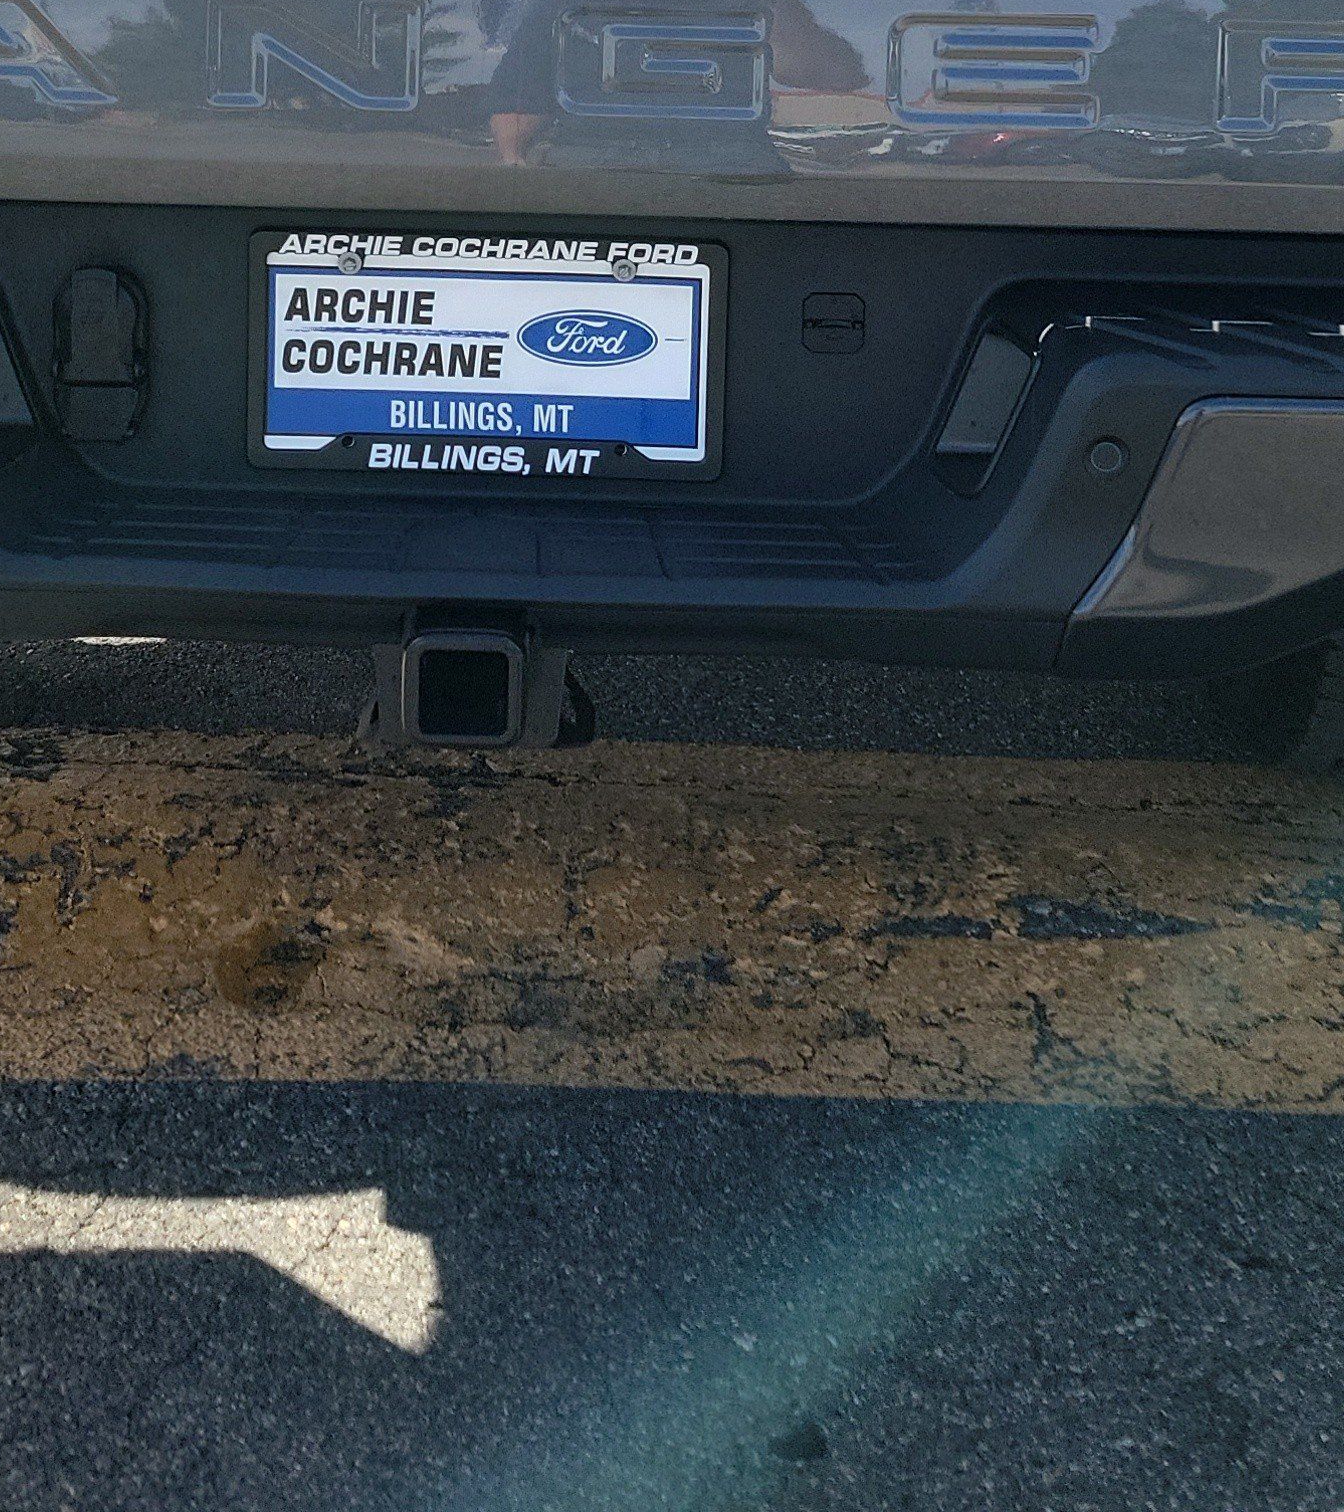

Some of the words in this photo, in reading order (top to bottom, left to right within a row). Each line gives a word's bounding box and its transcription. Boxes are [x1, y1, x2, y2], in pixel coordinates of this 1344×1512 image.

[278, 233, 402, 257] ARCHIE
[412, 236, 597, 263] COCHRANE
[607, 243, 699, 266] FORD
[283, 287, 437, 326] ARCHIE
[544, 315, 628, 356] Ford
[281, 337, 505, 380] COCHRANE
[390, 399, 523, 437] BILLINGS,
[533, 403, 574, 434] MT
[367, 442, 531, 474] BILLINGS,
[544, 448, 601, 475] MT
